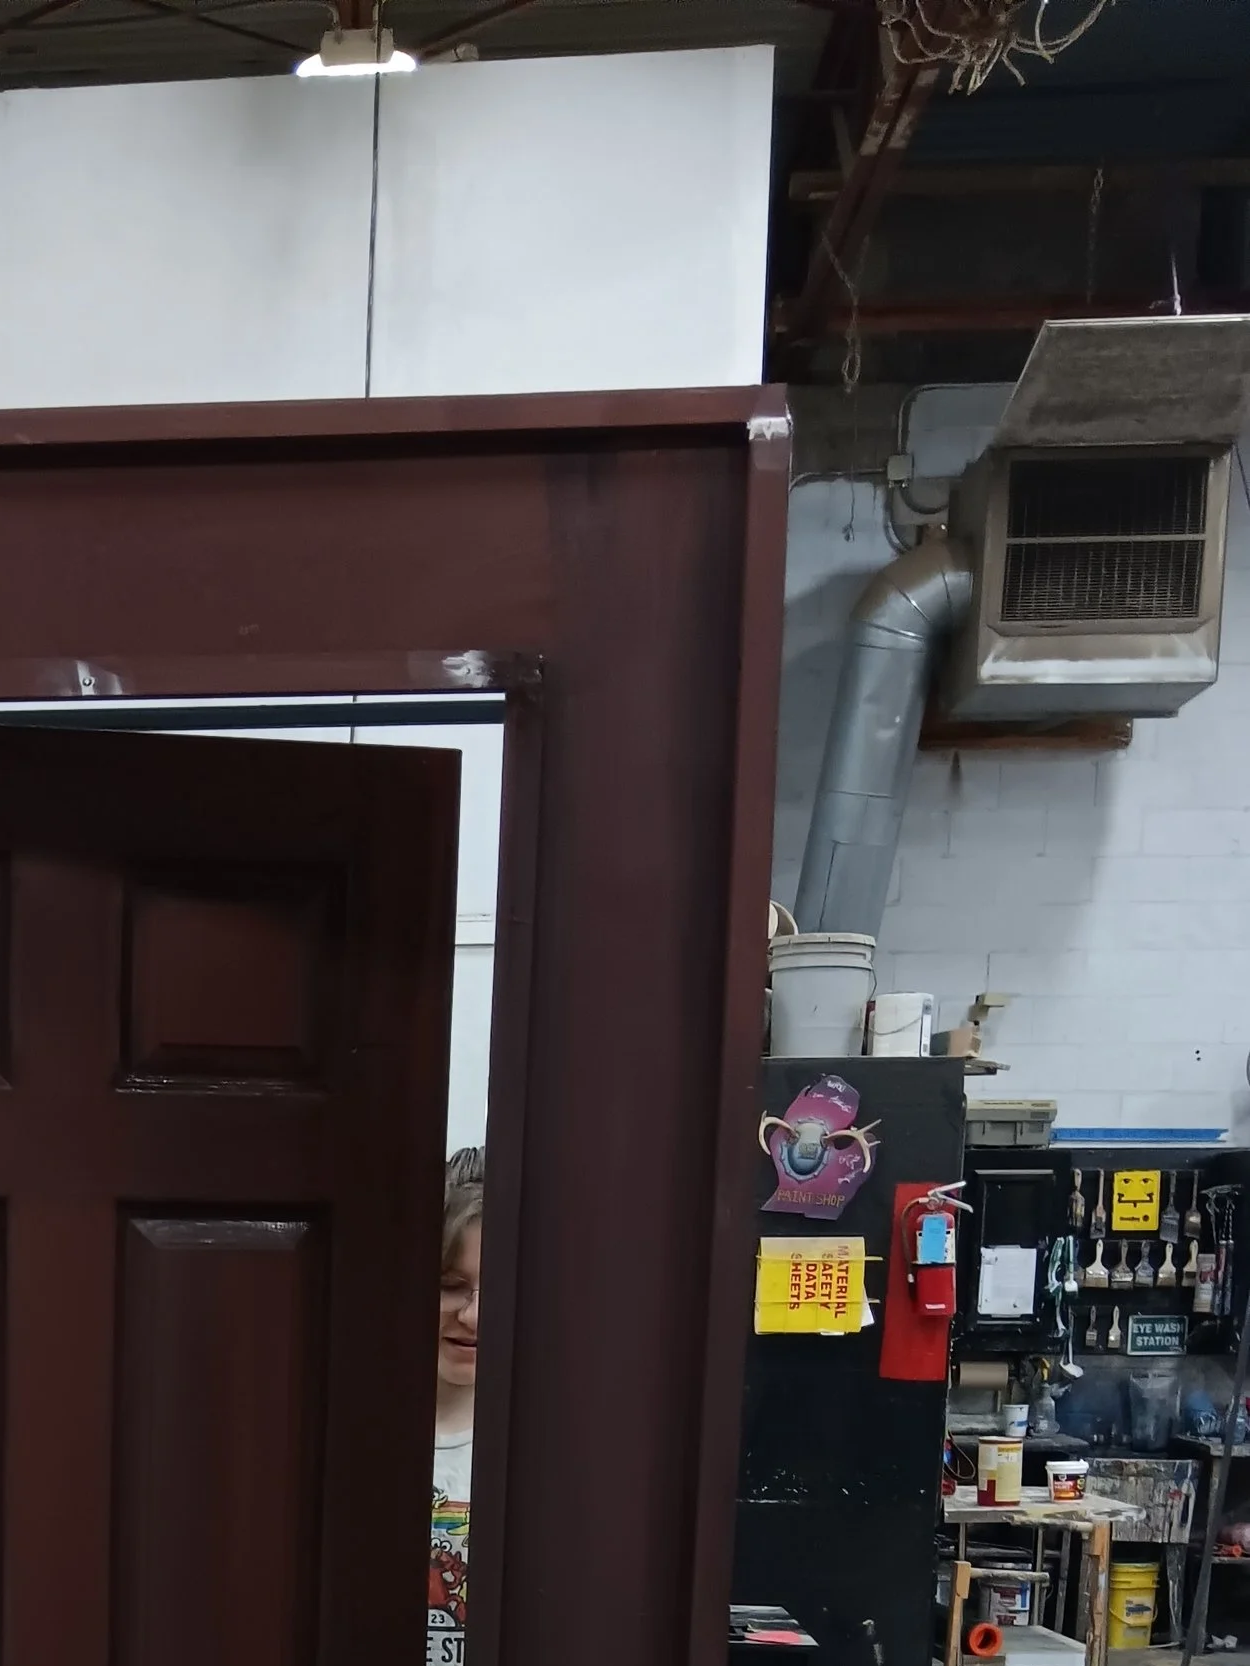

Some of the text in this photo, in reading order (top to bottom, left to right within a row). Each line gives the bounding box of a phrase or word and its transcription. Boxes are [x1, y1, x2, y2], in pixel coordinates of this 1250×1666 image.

[776, 1189, 846, 1207] PAINT SHOP
[789, 1252, 803, 1310] SHEETS
[804, 1262, 818, 1300] DATA
[820, 1252, 834, 1310] SAFETY
[834, 1245, 850, 1318] MATERIAL
[1132, 1322, 1184, 1334] EYE WASH
[1135, 1335, 1180, 1347] STATION
